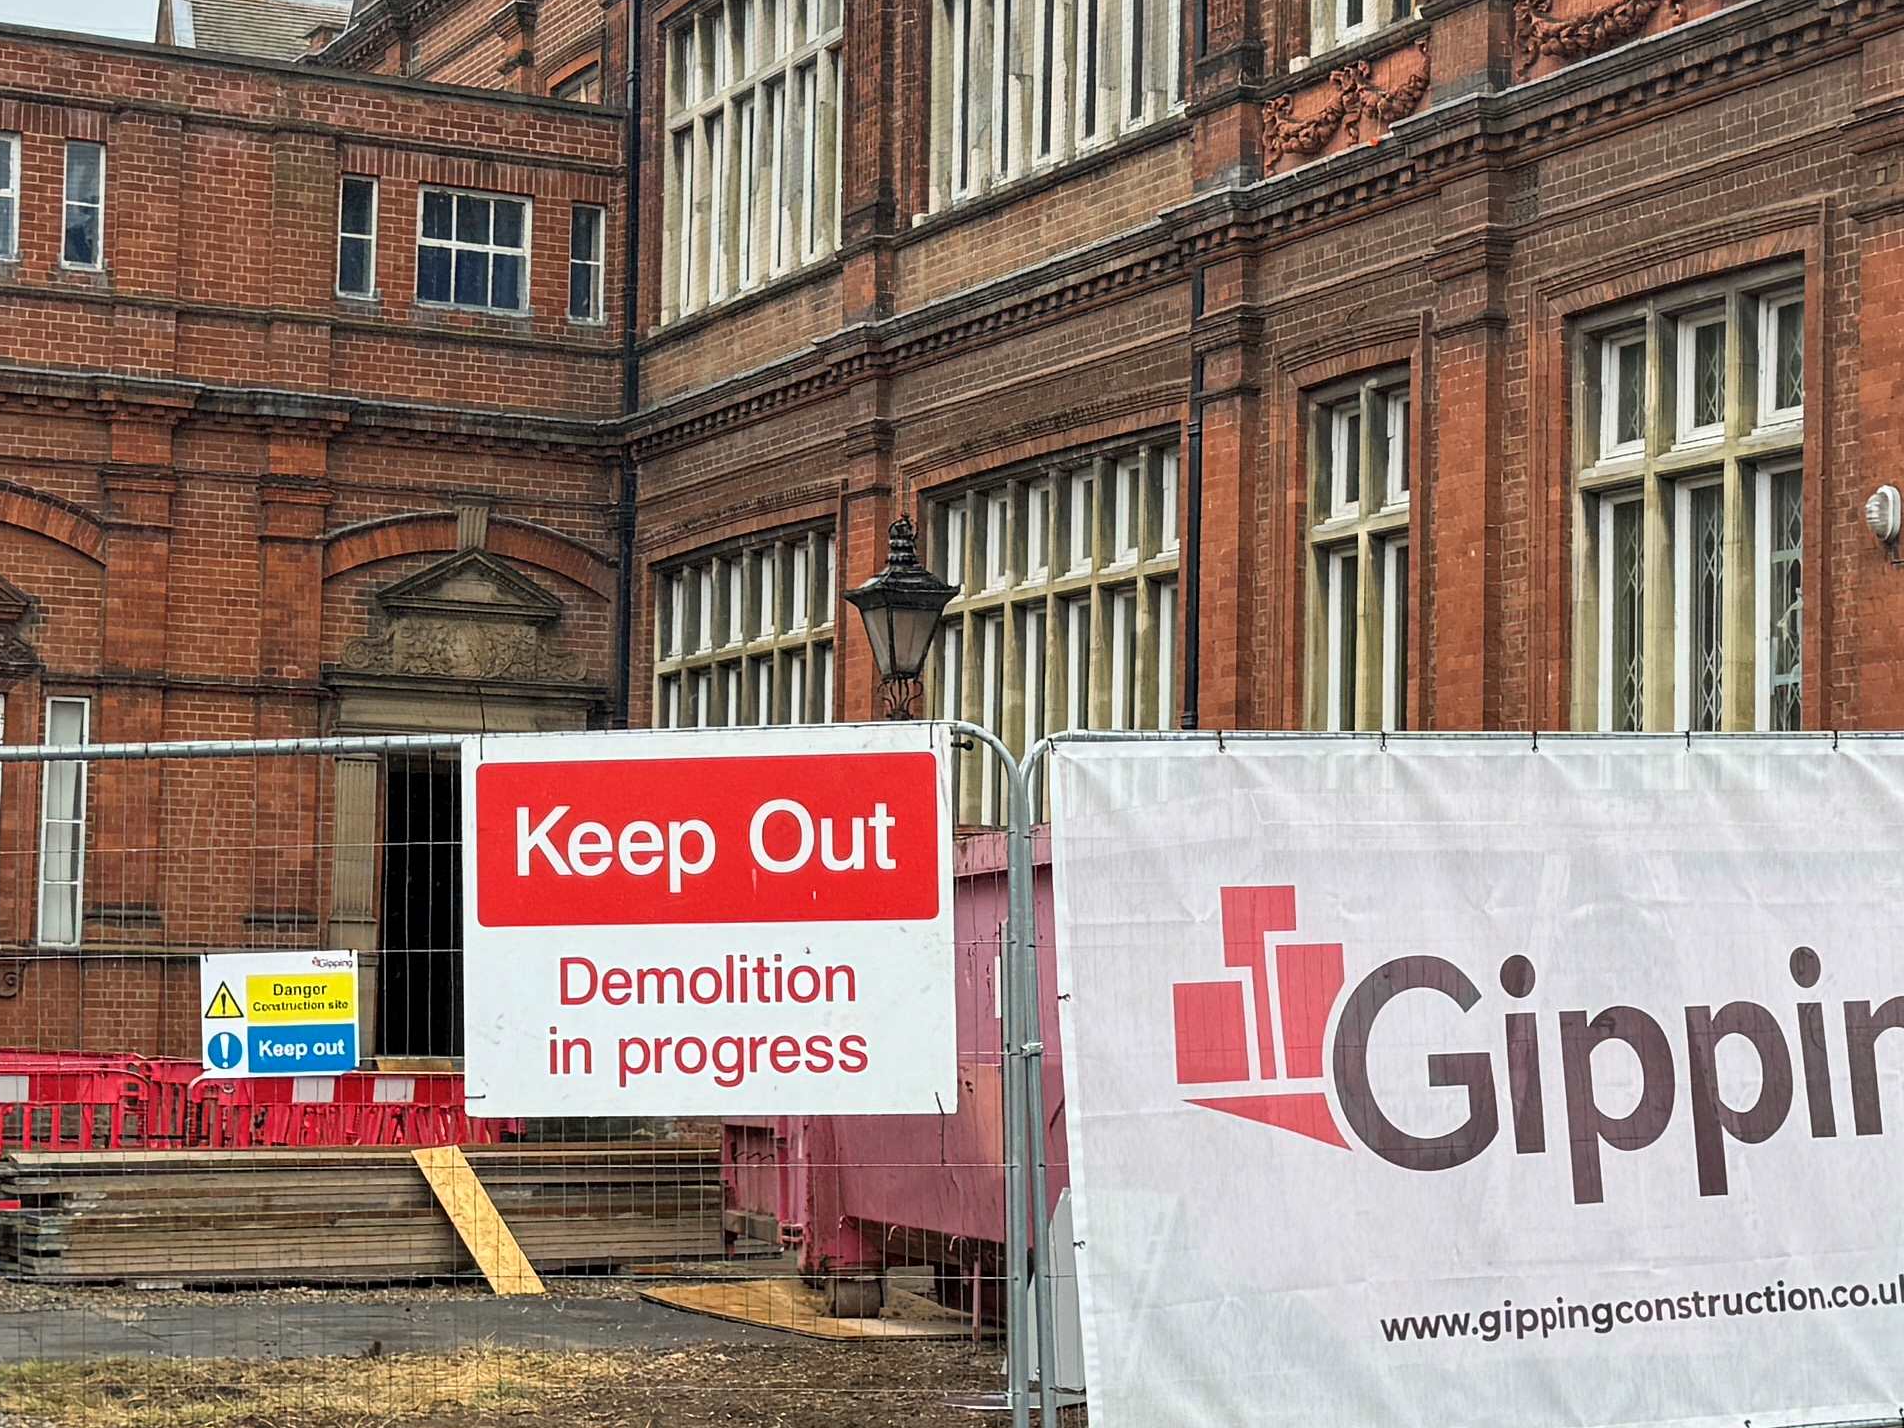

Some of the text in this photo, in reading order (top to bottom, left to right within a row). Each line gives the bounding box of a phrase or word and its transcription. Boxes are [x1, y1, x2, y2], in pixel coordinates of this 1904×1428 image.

[516, 798, 898, 893] Keep Out
[273, 983, 328, 998] Danger
[559, 953, 857, 1007] Demolition
[253, 1000, 348, 1012] Construction site
[258, 1039, 345, 1060] Keep out
[548, 1027, 869, 1087] in progress
